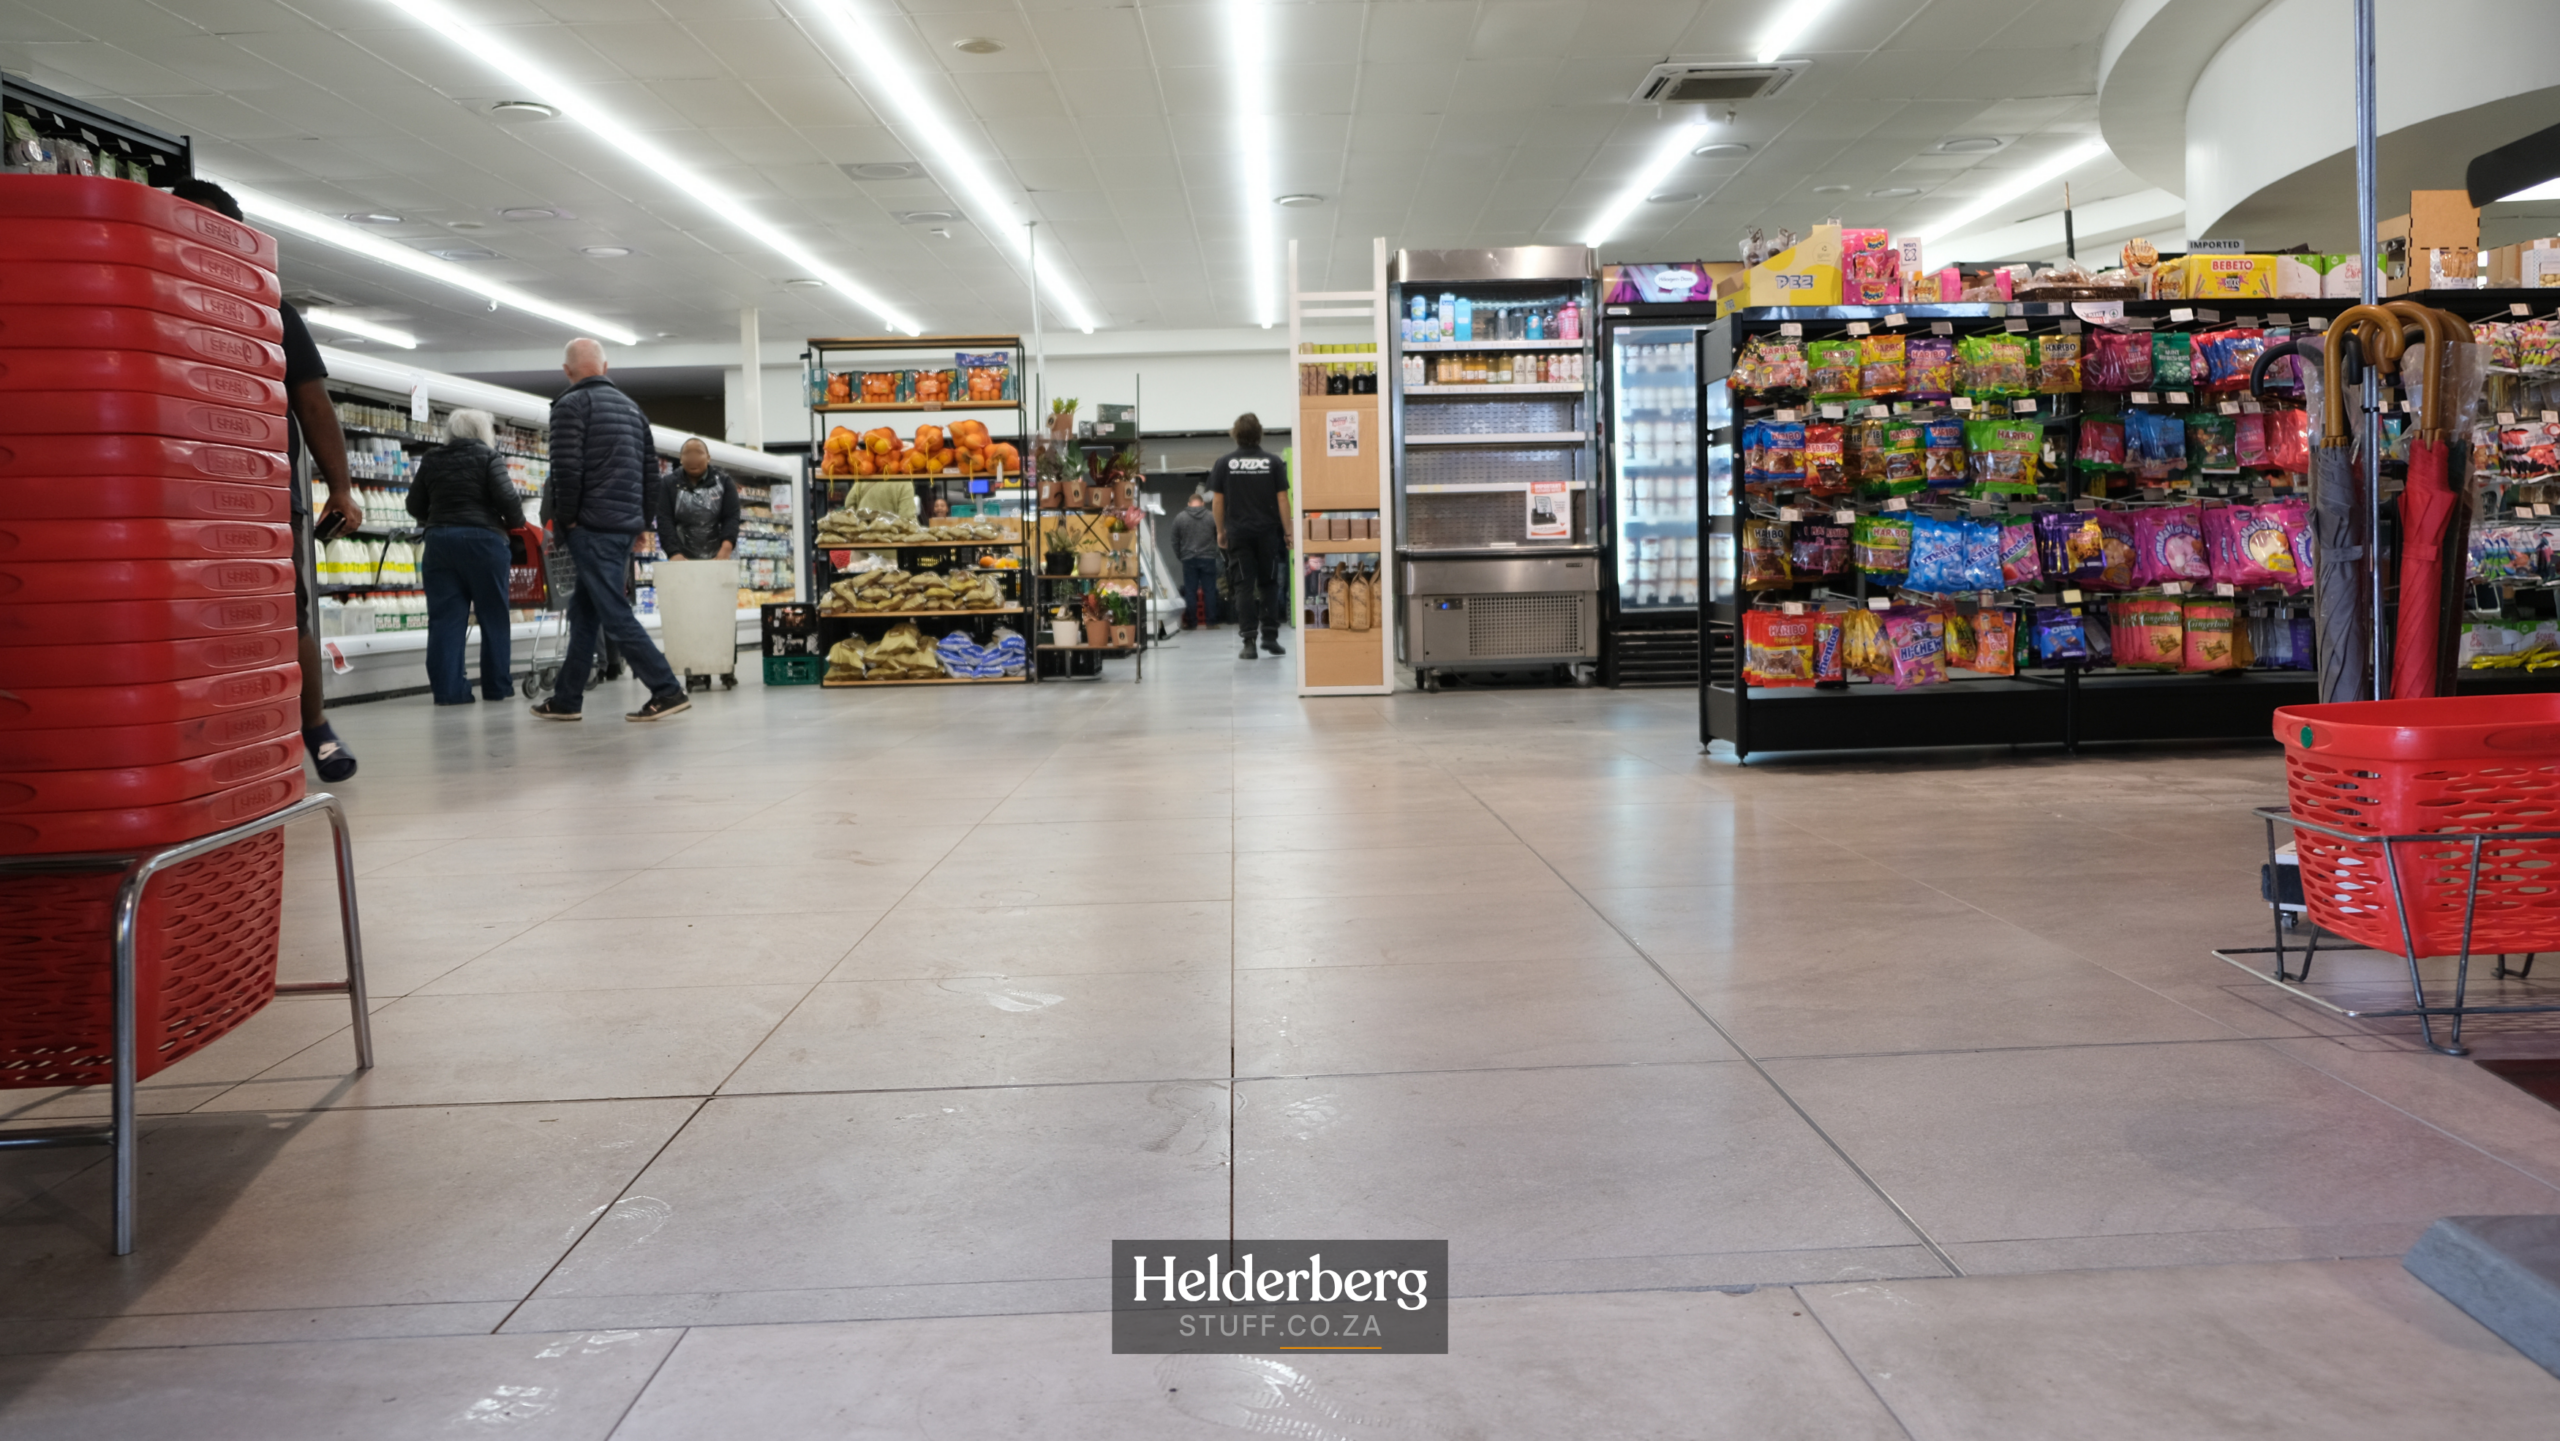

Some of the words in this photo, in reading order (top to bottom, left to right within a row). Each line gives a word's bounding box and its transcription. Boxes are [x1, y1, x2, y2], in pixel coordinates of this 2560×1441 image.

[204, 220, 232, 243] SPAR
[2190, 241, 2240, 249] IMPORTED
[208, 261, 236, 280] SPAR
[2212, 260, 2254, 270] BEBETO
[1776, 275, 1813, 289] PEZ
[210, 299, 238, 319] SPAR
[210, 337, 242, 356] SPAR
[1760, 344, 1797, 356] HARIBO
[2045, 343, 2076, 352] HARIBO
[1822, 349, 1856, 359] HARIBO
[1911, 349, 1947, 359] HARIBO
[215, 378, 243, 395] SPAR
[216, 417, 244, 433] SPAR
[1771, 431, 1801, 440] HARIBO
[1889, 428, 1923, 440] HARIBO
[1930, 426, 1960, 437] HARIBO
[1997, 429, 2035, 441] HARIBO
[1806, 443, 1839, 453] BEBETO
[216, 457, 246, 471] SPAR
[1240, 459, 1270, 469] RDC
[1754, 528, 1784, 539] HARIBO
[1873, 528, 1908, 538] HARIBO
[1923, 543, 1961, 564] mentos
[1769, 625, 1807, 636] HARIBO
[2187, 619, 2230, 632] Gingerbon
[1819, 627, 1840, 676] mentos
[1900, 638, 1943, 661] HI-CHEW
